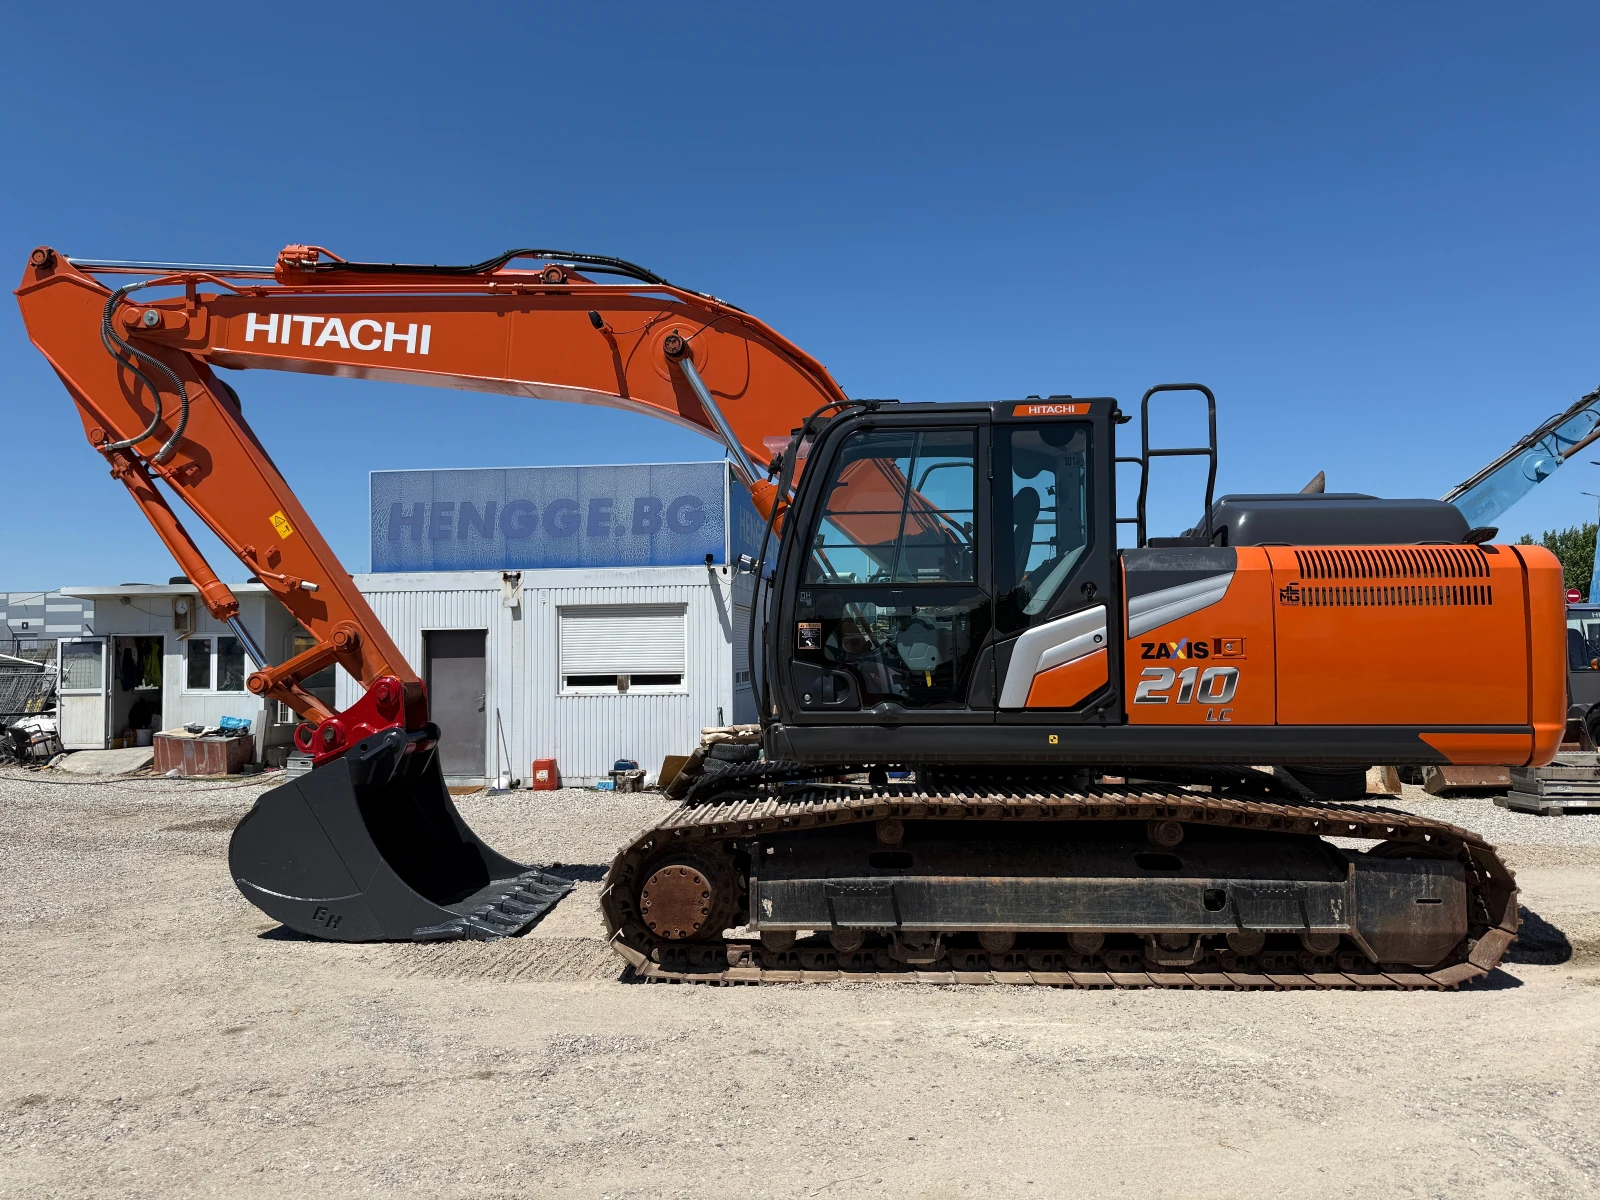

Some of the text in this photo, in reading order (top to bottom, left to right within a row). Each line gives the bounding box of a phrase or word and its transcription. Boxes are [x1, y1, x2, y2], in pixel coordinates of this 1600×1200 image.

[245, 313, 432, 355] HITACHI
[1029, 405, 1074, 414] HITACHI
[388, 496, 705, 541] HENGGE.BG
[1141, 637, 1209, 660] ZAXIS
[1133, 666, 1240, 705] 210
[1206, 708, 1233, 722] LC
[312, 905, 343, 929] EH
